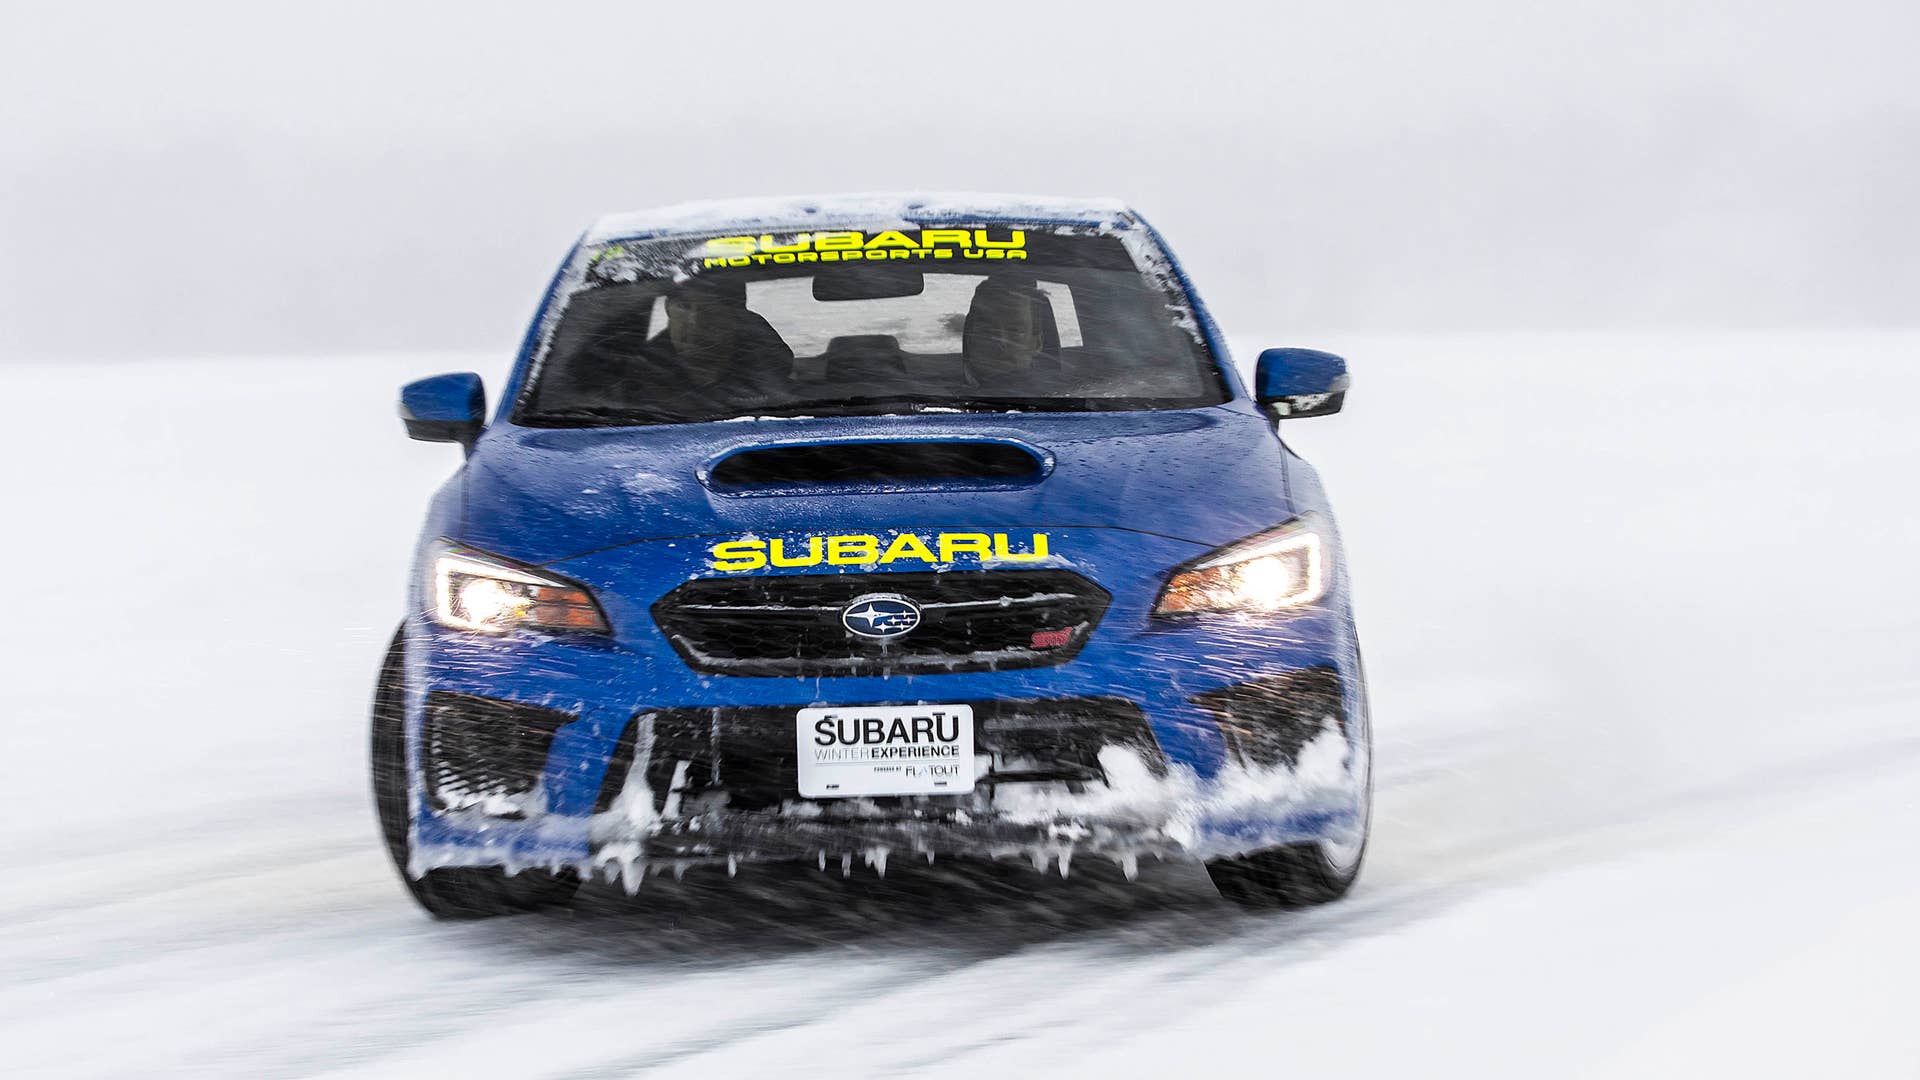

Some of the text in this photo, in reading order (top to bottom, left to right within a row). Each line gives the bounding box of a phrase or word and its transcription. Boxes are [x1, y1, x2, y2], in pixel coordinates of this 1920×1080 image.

[703, 248, 1028, 269] MOTORSPORTS USA
[713, 533, 1049, 571] SUBARU
[814, 715, 960, 746] SUBARU
[871, 744, 960, 759] EXPERIENCE
